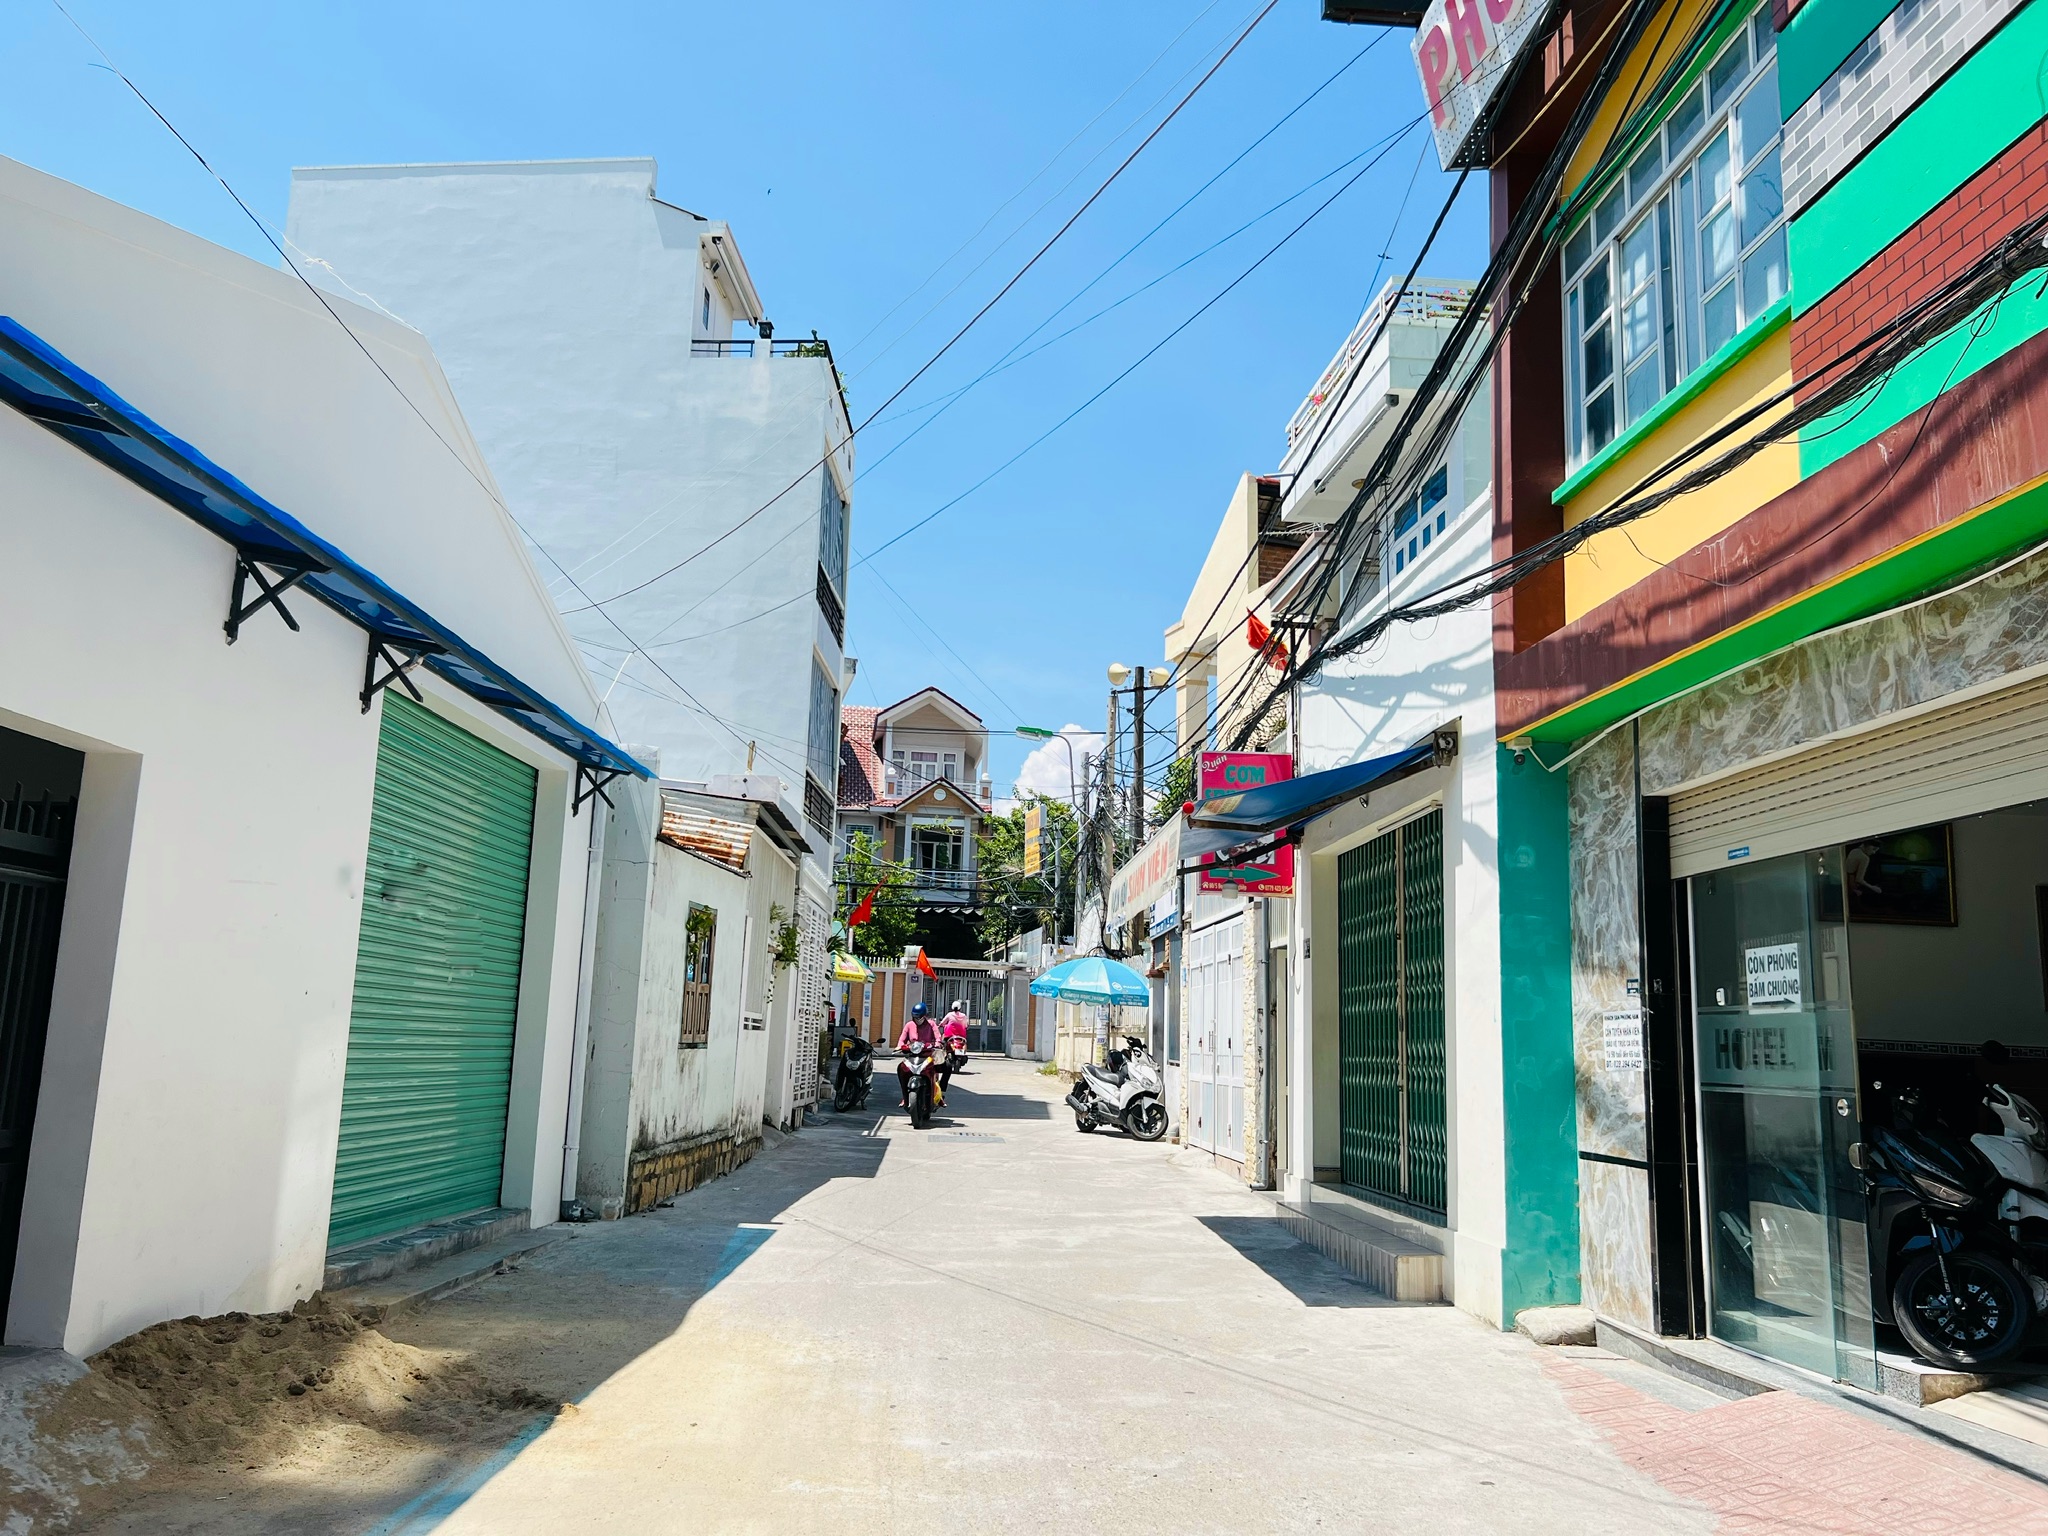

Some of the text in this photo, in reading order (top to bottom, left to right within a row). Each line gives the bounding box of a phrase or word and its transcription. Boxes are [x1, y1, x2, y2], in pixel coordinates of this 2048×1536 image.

[1202, 754, 1227, 772] Quán
[1128, 861, 1146, 904] SINH
[1747, 948, 1798, 974] CÒN PHÒNG
[1749, 975, 1799, 998] BẤM CHUÔNG
[1715, 1027, 1796, 1071] HOTEL
